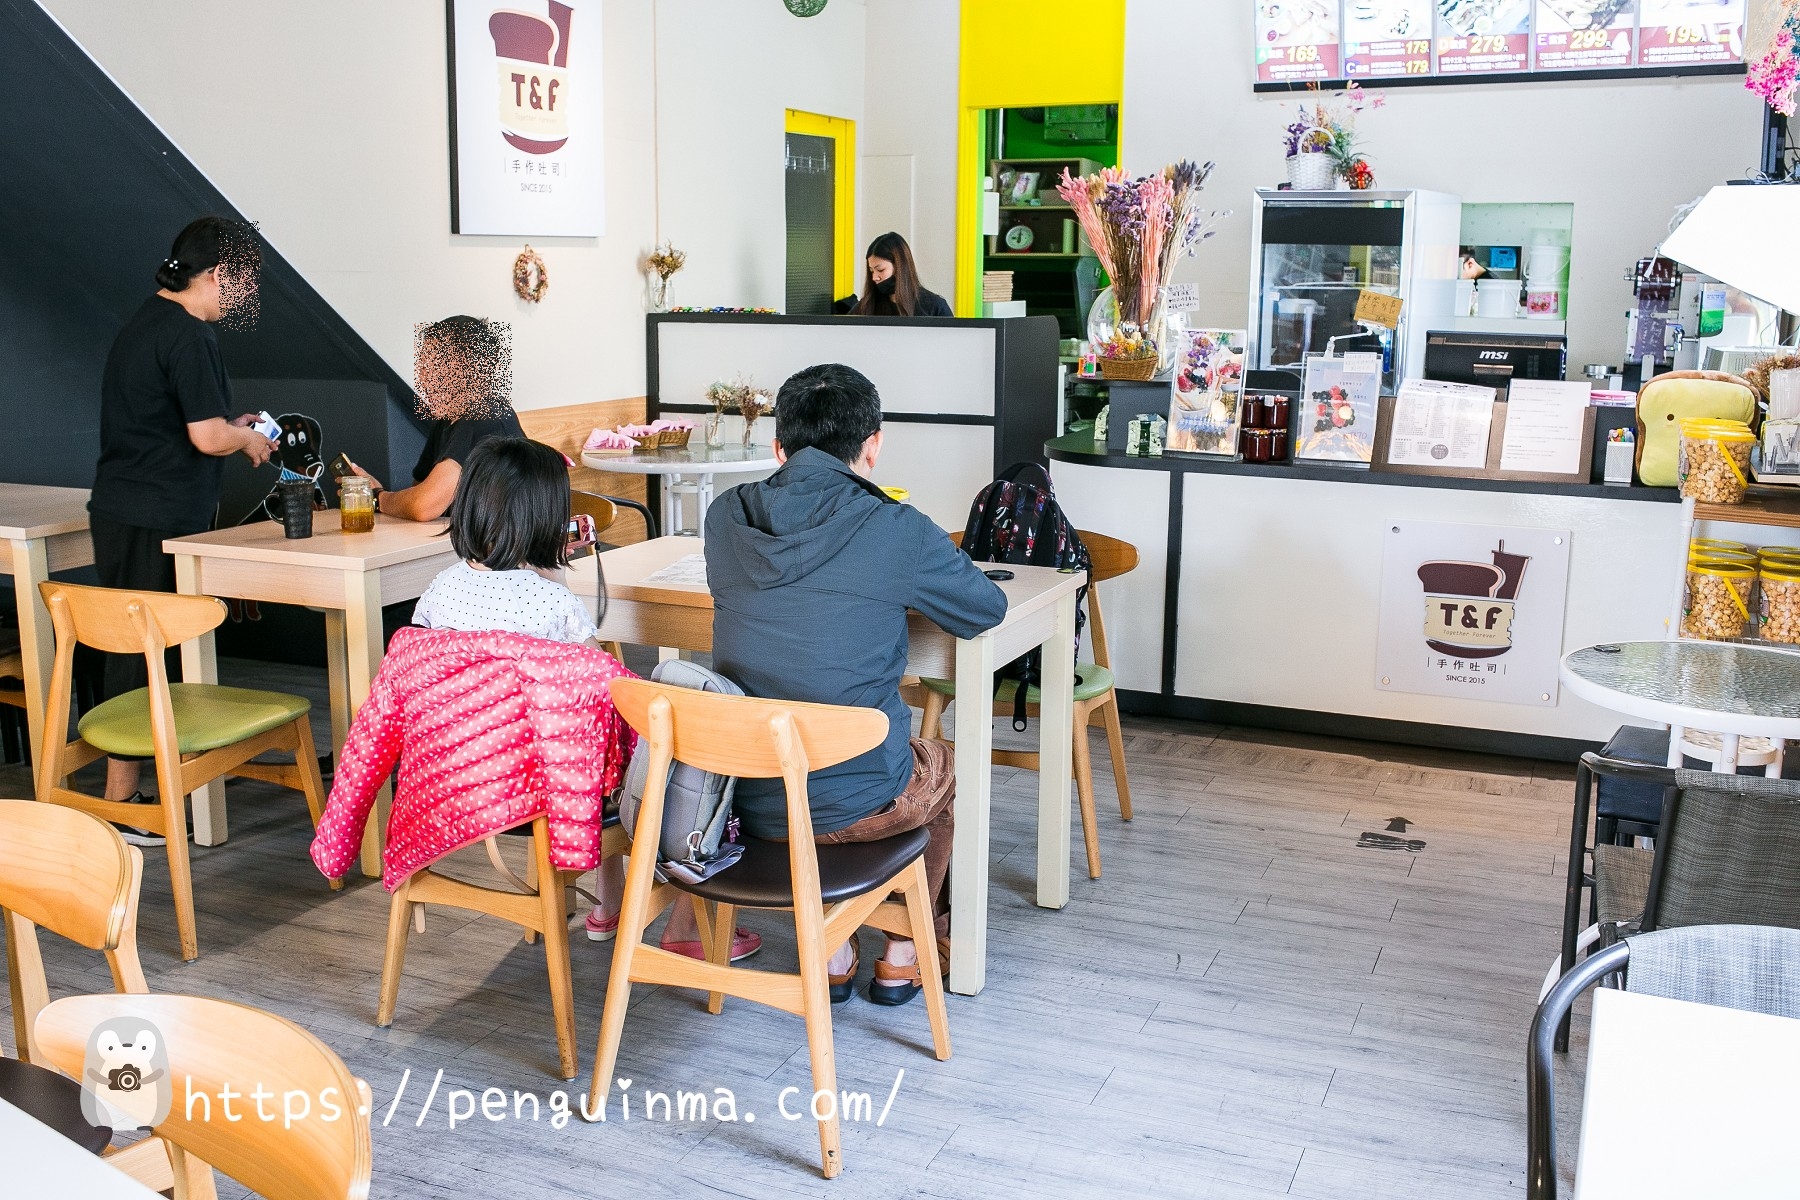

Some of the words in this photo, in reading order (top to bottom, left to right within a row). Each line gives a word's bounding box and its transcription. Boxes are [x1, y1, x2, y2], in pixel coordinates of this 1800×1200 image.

[512, 159, 560, 177] 手作吐司
[520, 182, 538, 193] SINCE
[1479, 350, 1509, 360] msi
[1437, 659, 1497, 673] 手作吐司
[1446, 675, 1467, 683] SINCE
